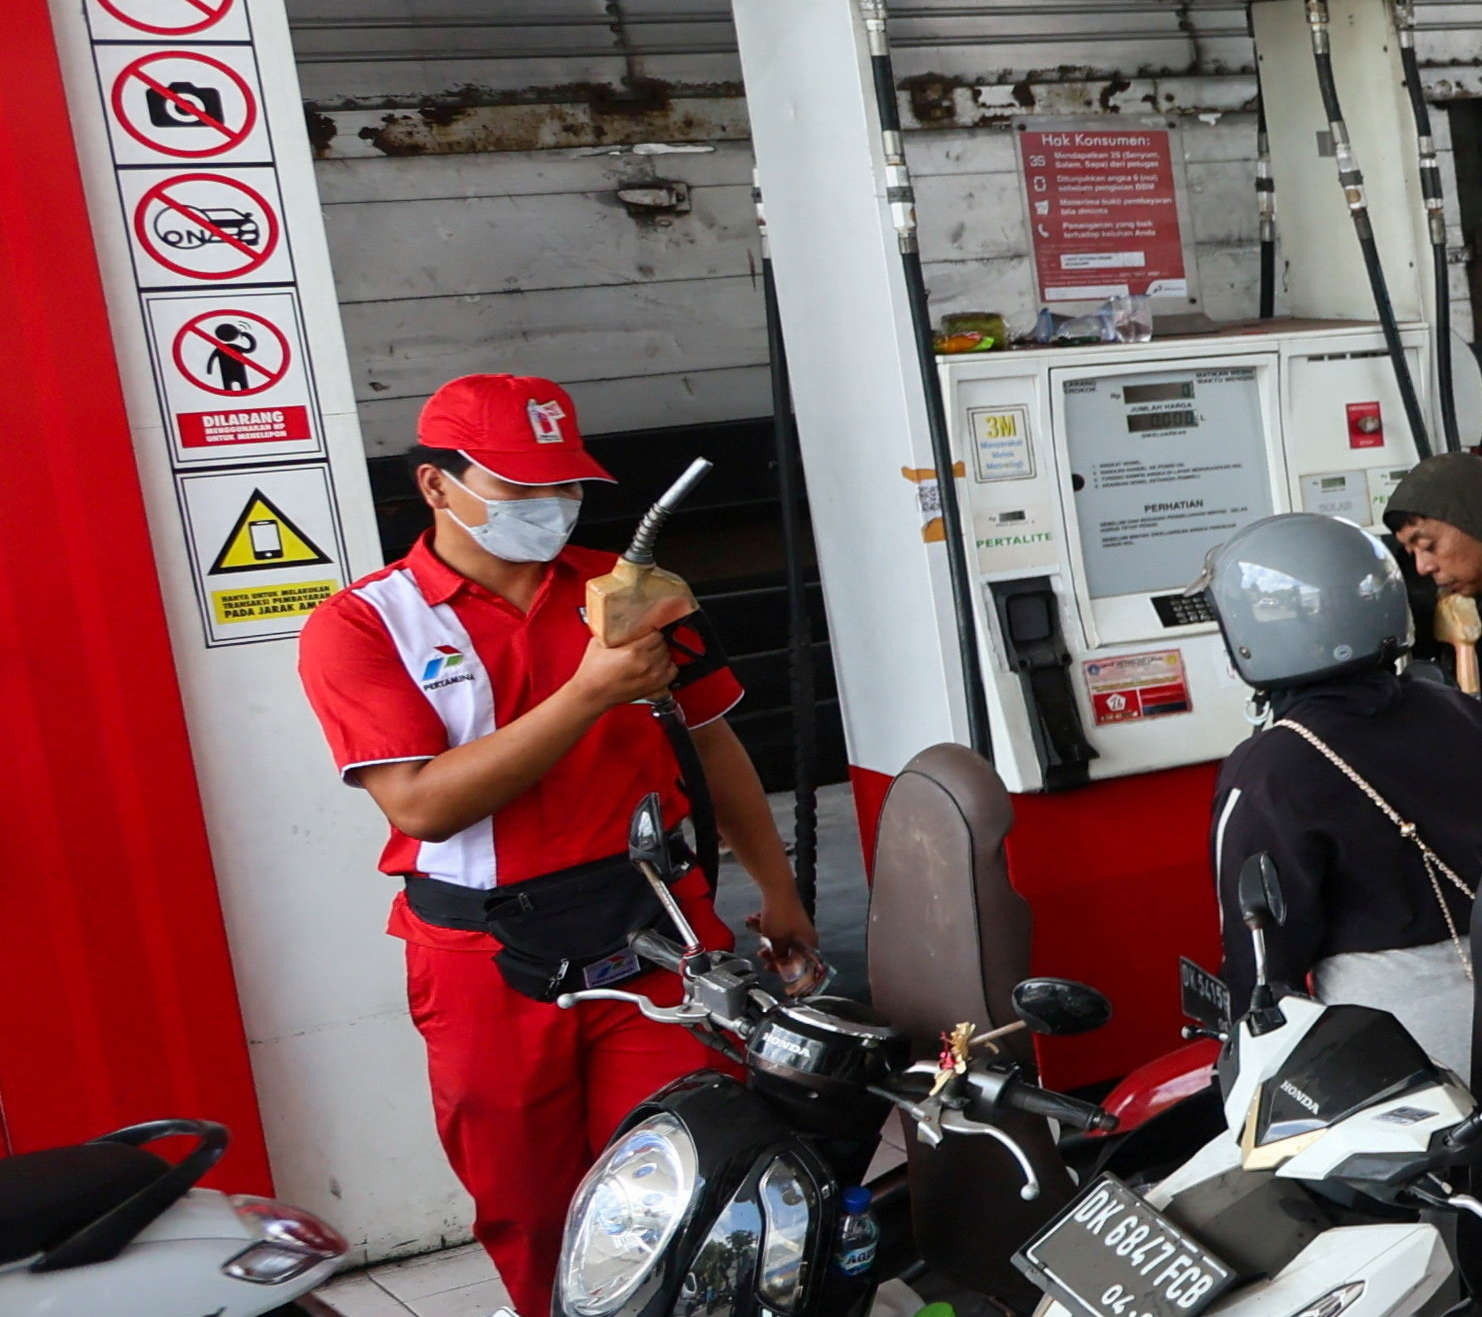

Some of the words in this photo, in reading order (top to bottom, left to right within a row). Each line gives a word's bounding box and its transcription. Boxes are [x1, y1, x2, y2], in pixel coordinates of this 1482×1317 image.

[1041, 134, 1071, 147] Hak
[1074, 134, 1151, 147] Konsumen:
[202, 411, 284, 427] DILARANG
[984, 414, 1017, 438] 3M
[1144, 499, 1203, 513] PERHATIAN
[975, 532, 1053, 548] PERTALITE
[224, 607, 255, 619] PADA
[257, 603, 295, 616] JARAK
[424, 672, 475, 692] PERTAMINA
[1182, 961, 1200, 985] DK
[763, 1032, 811, 1057] HONDA
[1281, 1079, 1321, 1116] HONDA
[1073, 1191, 1113, 1236] DK
[1105, 1215, 1171, 1276] 6847
[1153, 1256, 1214, 1310] FCB
